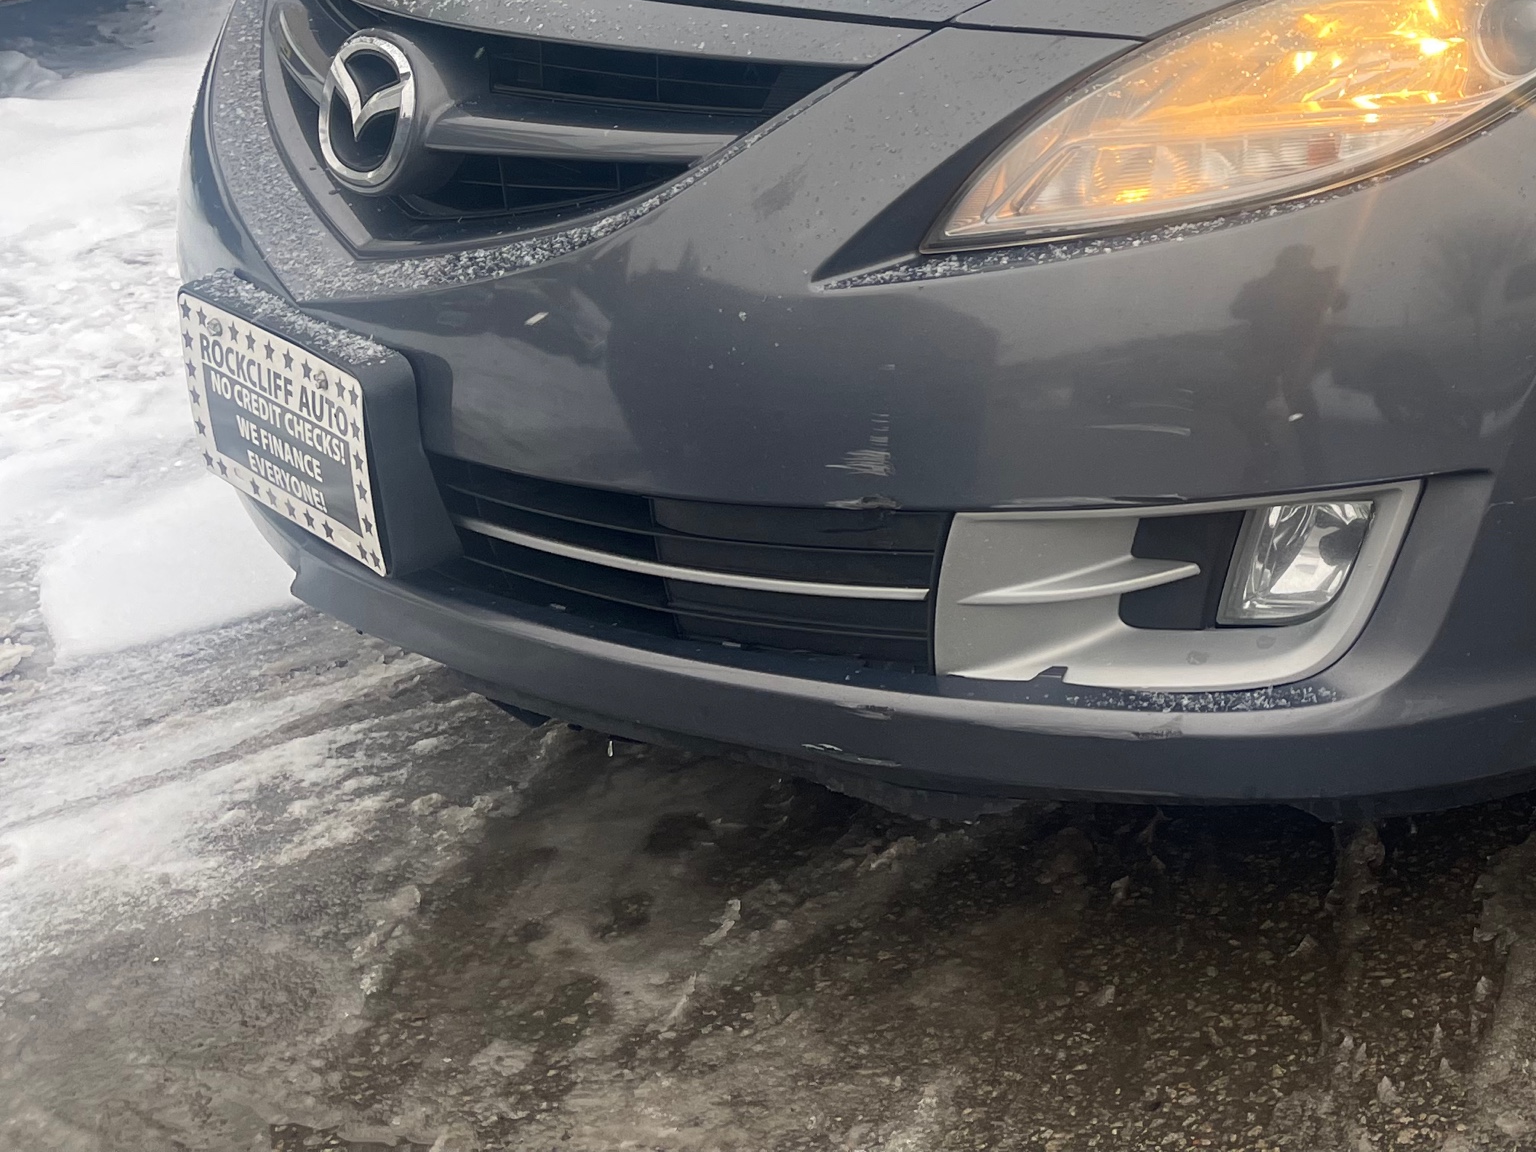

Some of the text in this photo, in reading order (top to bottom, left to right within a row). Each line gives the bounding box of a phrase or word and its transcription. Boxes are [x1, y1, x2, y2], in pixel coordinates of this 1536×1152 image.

[199, 333, 349, 438] ROCKCLIFF AUTO
[211, 370, 346, 465] NO CREDIT CHECKS!
[236, 414, 323, 483] WE FINANCE
[247, 449, 328, 513] EVERYONE!
